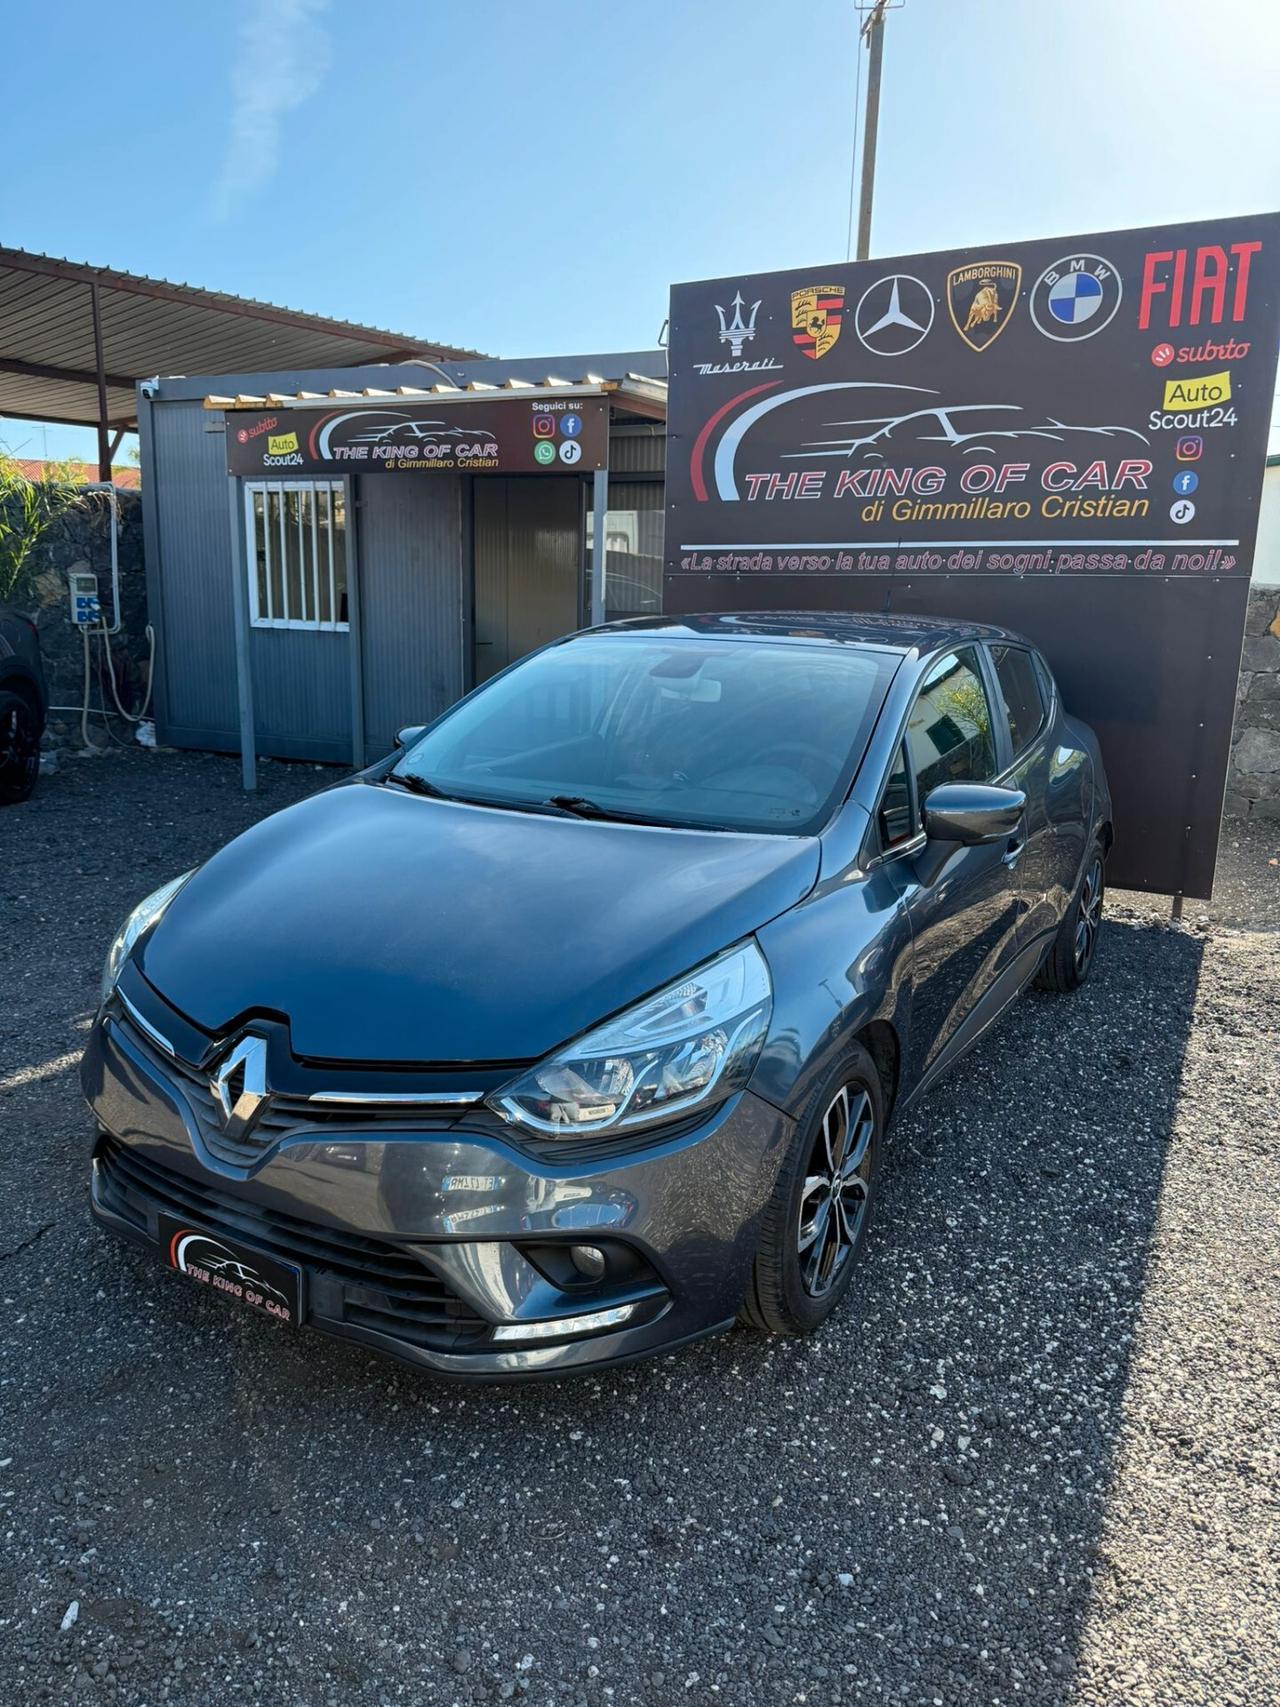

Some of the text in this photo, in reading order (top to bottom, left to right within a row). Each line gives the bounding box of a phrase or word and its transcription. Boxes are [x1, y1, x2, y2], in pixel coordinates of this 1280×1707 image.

[953, 266, 1016, 287] LAMBORGHINI
[1044, 259, 1111, 287] BMW
[792, 286, 844, 299] PORSCHE
[1138, 241, 1262, 330] FIAT
[1176, 338, 1251, 362] subito
[693, 357, 784, 375] Maserati
[1168, 384, 1222, 403] Auto
[531, 402, 583, 412] Seguici su:
[248, 416, 278, 437] subito
[1148, 407, 1238, 430] Scout24
[270, 439, 295, 450] Auto
[333, 443, 499, 459] THE KING OF CAR
[263, 453, 304, 466] Scout24
[385, 457, 499, 469] di Gimmillaro Cristian
[745, 459, 1153, 501] THE KING OF CAR
[861, 494, 1149, 521] di Gimmillaro Cristian
[716, 551, 773, 570] strada
[777, 556, 831, 570] verso
[835, 551, 853, 569] la
[858, 552, 890, 569] tua
[895, 551, 943, 569] auto
[948, 549, 983, 570] dei
[986, 549, 1053, 575] sogni
[1055, 553, 1128, 575] passa
[1133, 549, 1166, 570] da
[186, 1263, 291, 1321] THE KING OF CAR
